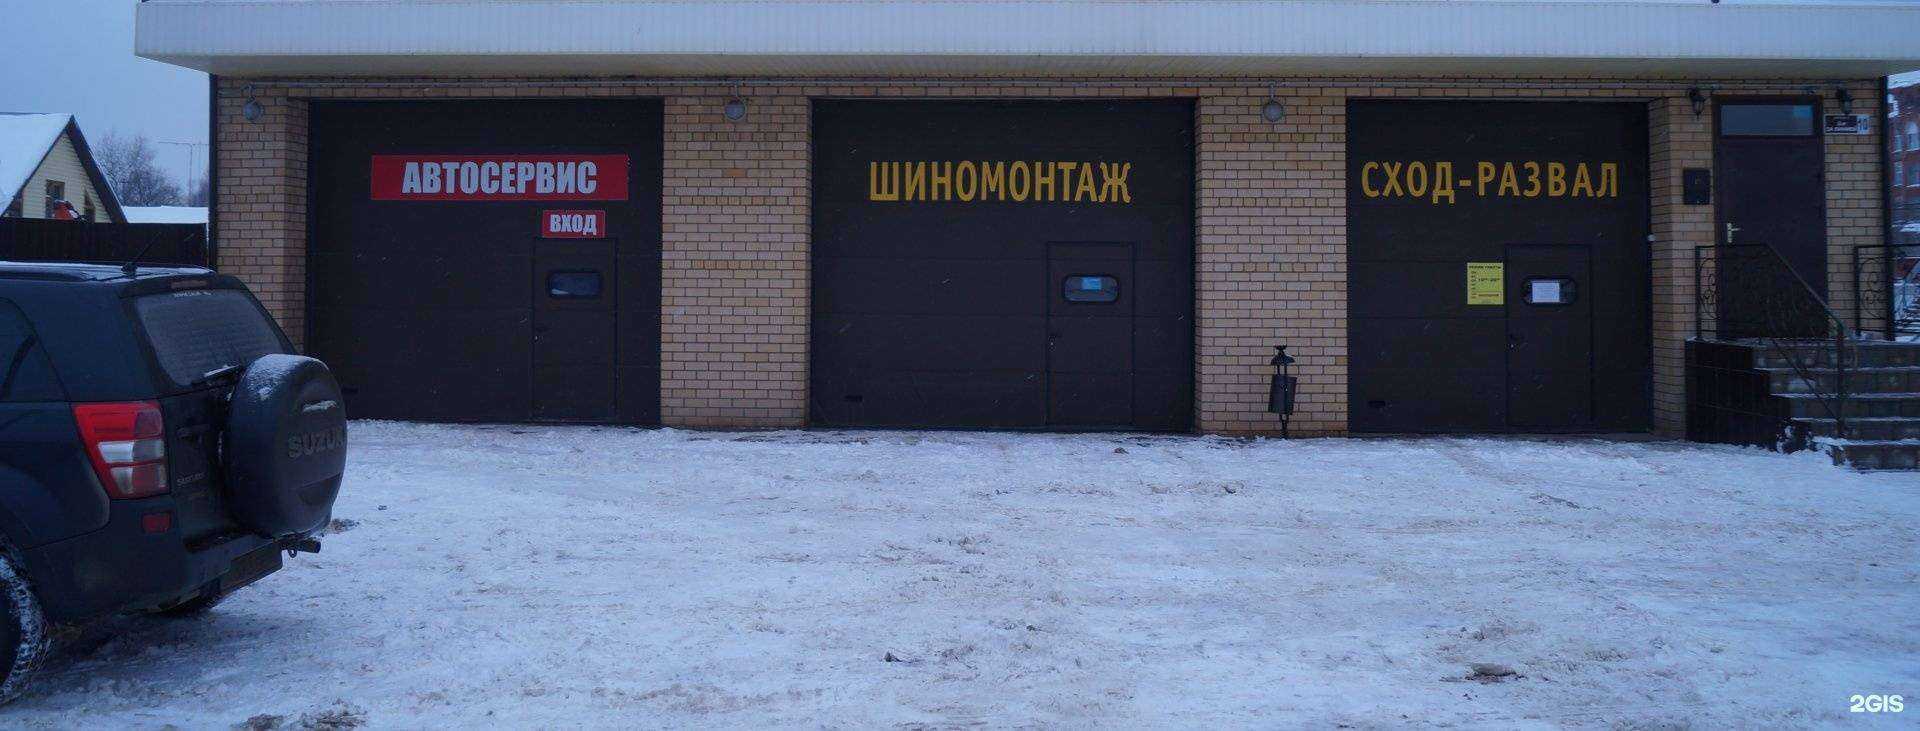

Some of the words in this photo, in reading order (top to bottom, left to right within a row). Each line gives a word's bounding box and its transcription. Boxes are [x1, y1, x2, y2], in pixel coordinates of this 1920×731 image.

[401, 161, 597, 194] АВТОСЕРВИС
[869, 161, 1131, 203] ШИНОМОНТАЖ
[1361, 161, 1618, 204] СХОД-РАЗВАЛ
[549, 214, 597, 235] ВХОД
